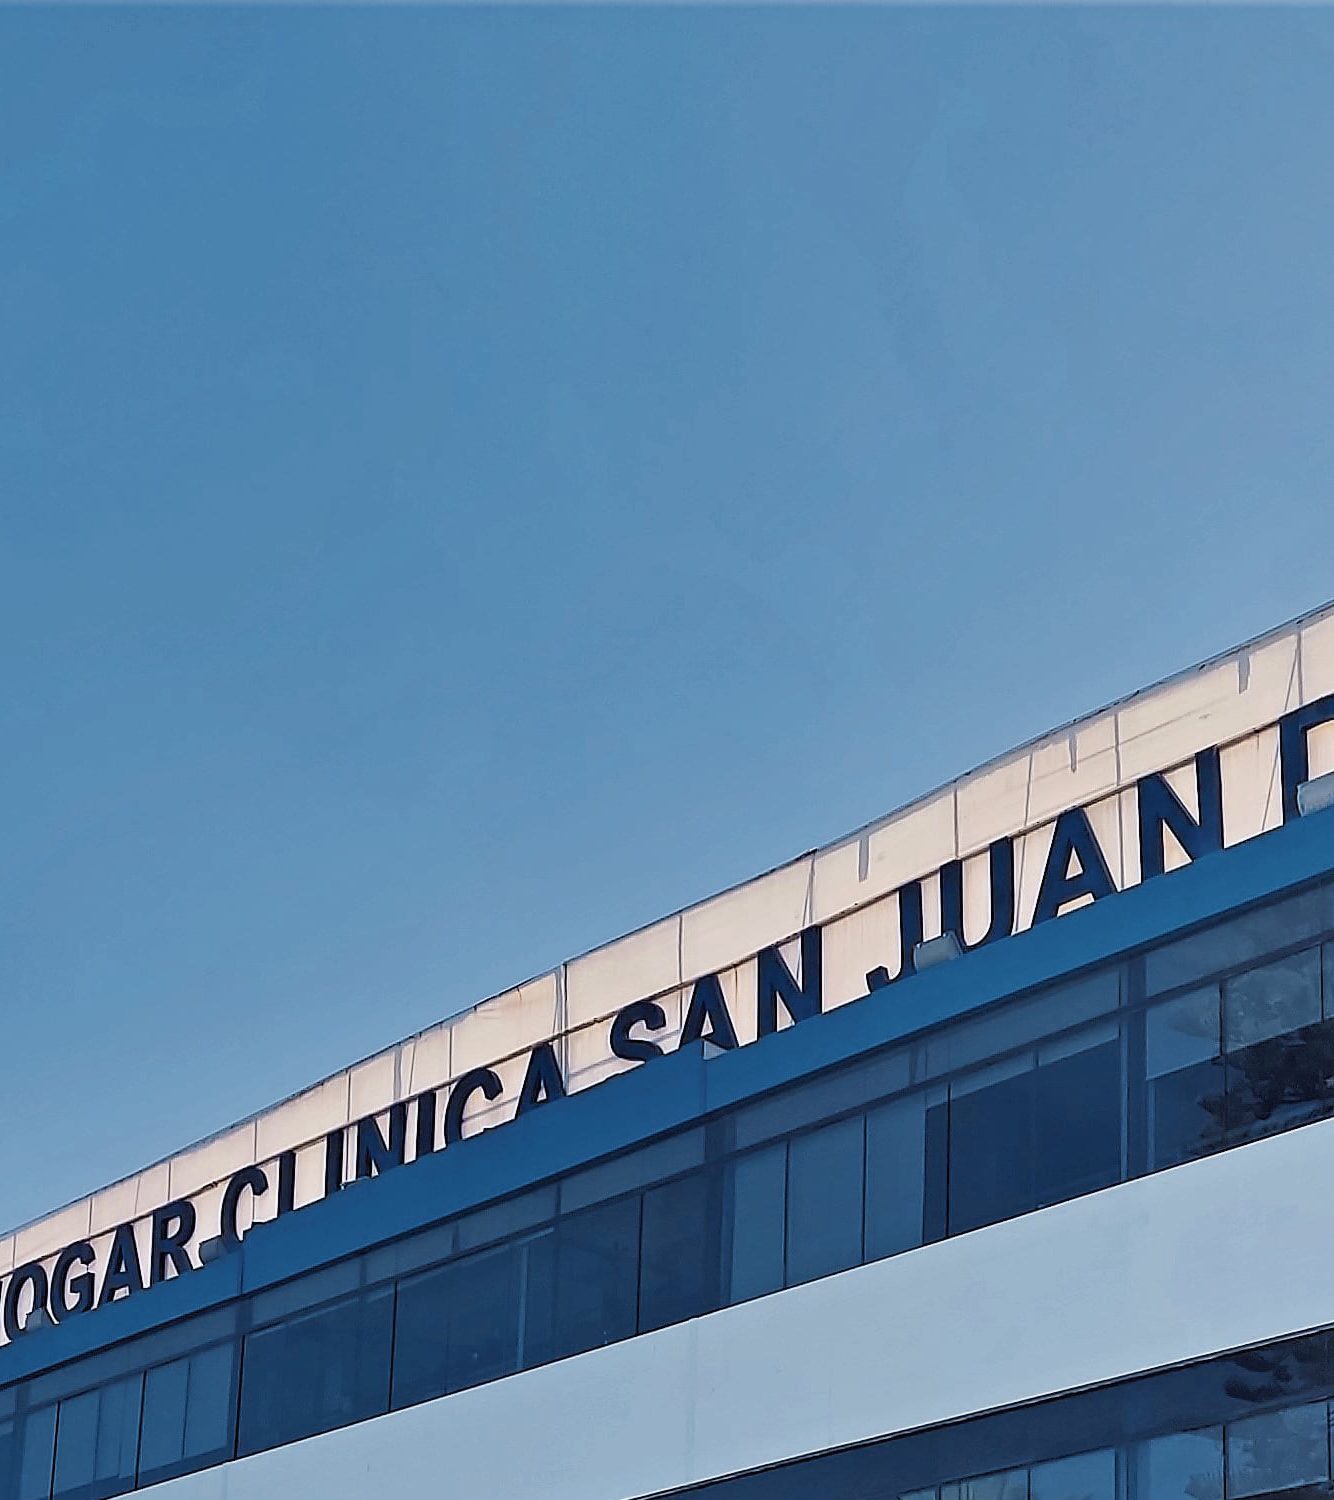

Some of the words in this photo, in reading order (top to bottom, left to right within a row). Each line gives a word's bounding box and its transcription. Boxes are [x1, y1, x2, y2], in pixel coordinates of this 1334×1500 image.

[221, 1042, 567, 1245] CLINICA
[609, 926, 823, 1063] SAN
[867, 746, 1224, 994] JUAN
